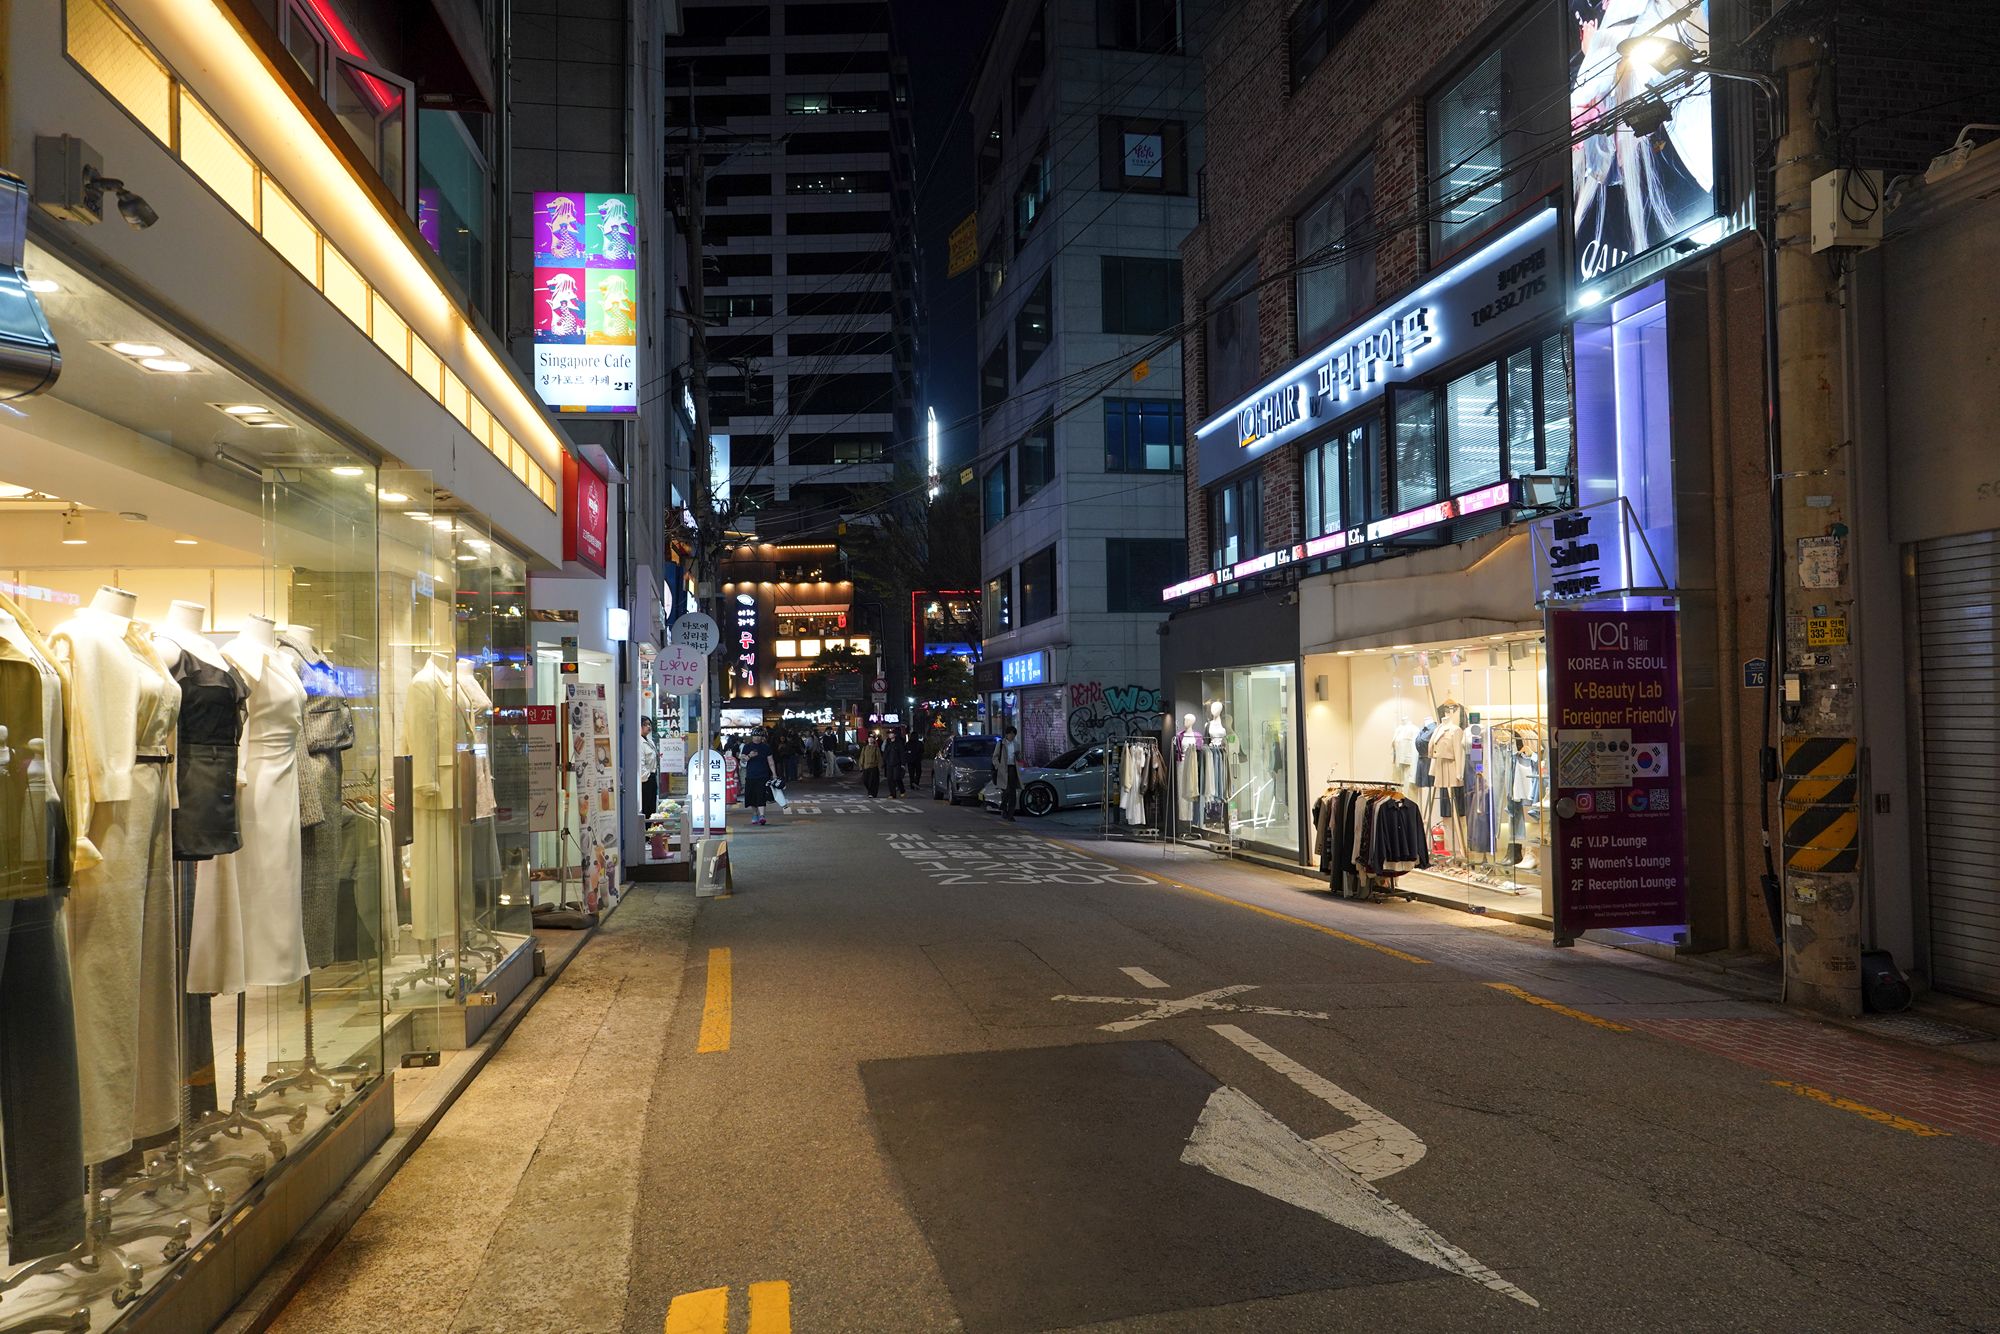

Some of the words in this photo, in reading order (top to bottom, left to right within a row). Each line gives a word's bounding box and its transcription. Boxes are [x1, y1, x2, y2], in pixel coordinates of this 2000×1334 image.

[540, 353, 600, 369] Singapore
[604, 353, 631, 368] Cafe
[614, 381, 633, 391] 2F
[1265, 385, 1300, 433] HAIR
[1550, 541, 1600, 568] Salon
[682, 622, 709, 631] 타로에
[1588, 621, 1629, 651] VOG
[1633, 636, 1649, 652] Hair
[676, 648, 683, 660] I
[1568, 658, 1610, 671] KOREA
[1613, 658, 1624, 670] in
[1627, 657, 1668, 670] SEOUL
[663, 674, 694, 687] Flat
[1751, 673, 1764, 684] 76
[1574, 682, 1636, 703] K-Beauty
[1639, 681, 1663, 698] Lab
[541, 709, 553, 721] 2F
[1563, 707, 1622, 728] Foreigner
[1625, 706, 1677, 727] Friendly
[1570, 837, 1583, 848] 4F
[1588, 836, 1609, 848] V.I.P
[1611, 835, 1648, 849] Lounge
[914, 861, 1120, 872] 12:00
[1570, 858, 1583, 870] 3F
[1588, 856, 1633, 869] Women's
[1635, 855, 1671, 869] Lounge
[929, 873, 1159, 885] 23:00
[1571, 879, 1584, 891] 2F
[1588, 877, 1638, 891] Reception
[1640, 876, 1677, 890] Lounge
